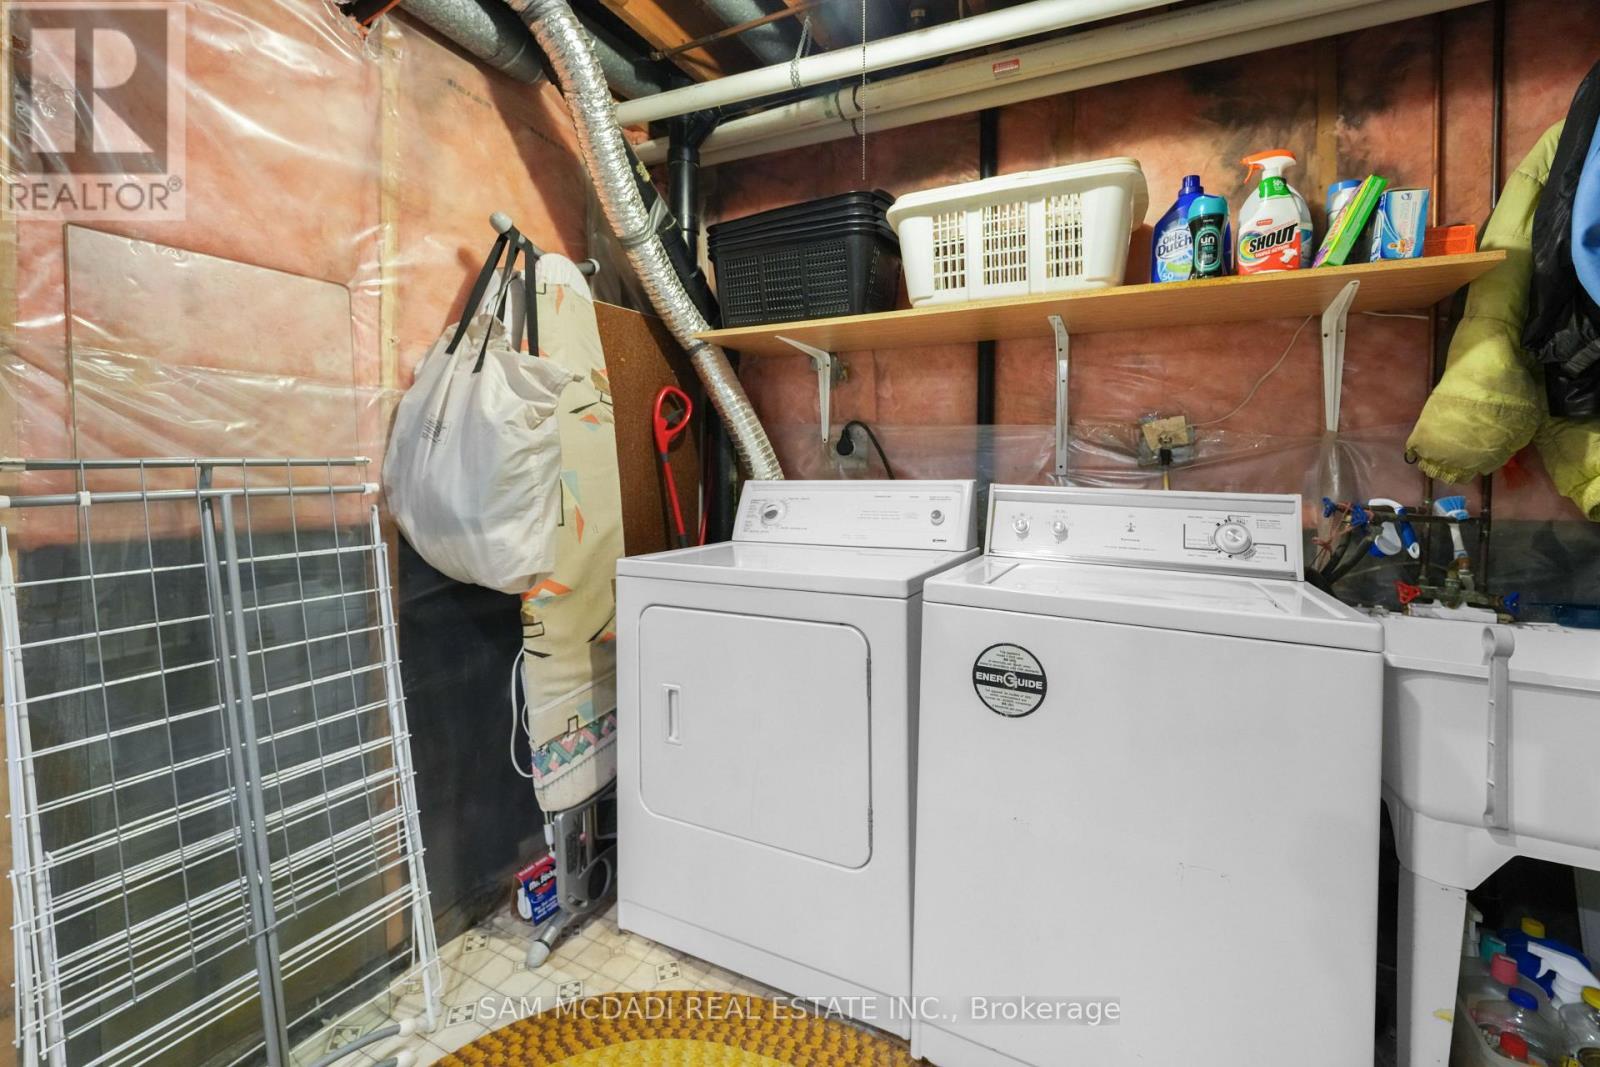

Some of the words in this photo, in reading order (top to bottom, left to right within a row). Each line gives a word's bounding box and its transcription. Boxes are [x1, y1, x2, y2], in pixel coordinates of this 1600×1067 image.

[1157, 234, 1193, 257] Dutch
[1249, 223, 1298, 253] SHOUT
[975, 671, 1043, 690] ENERGUIDE
